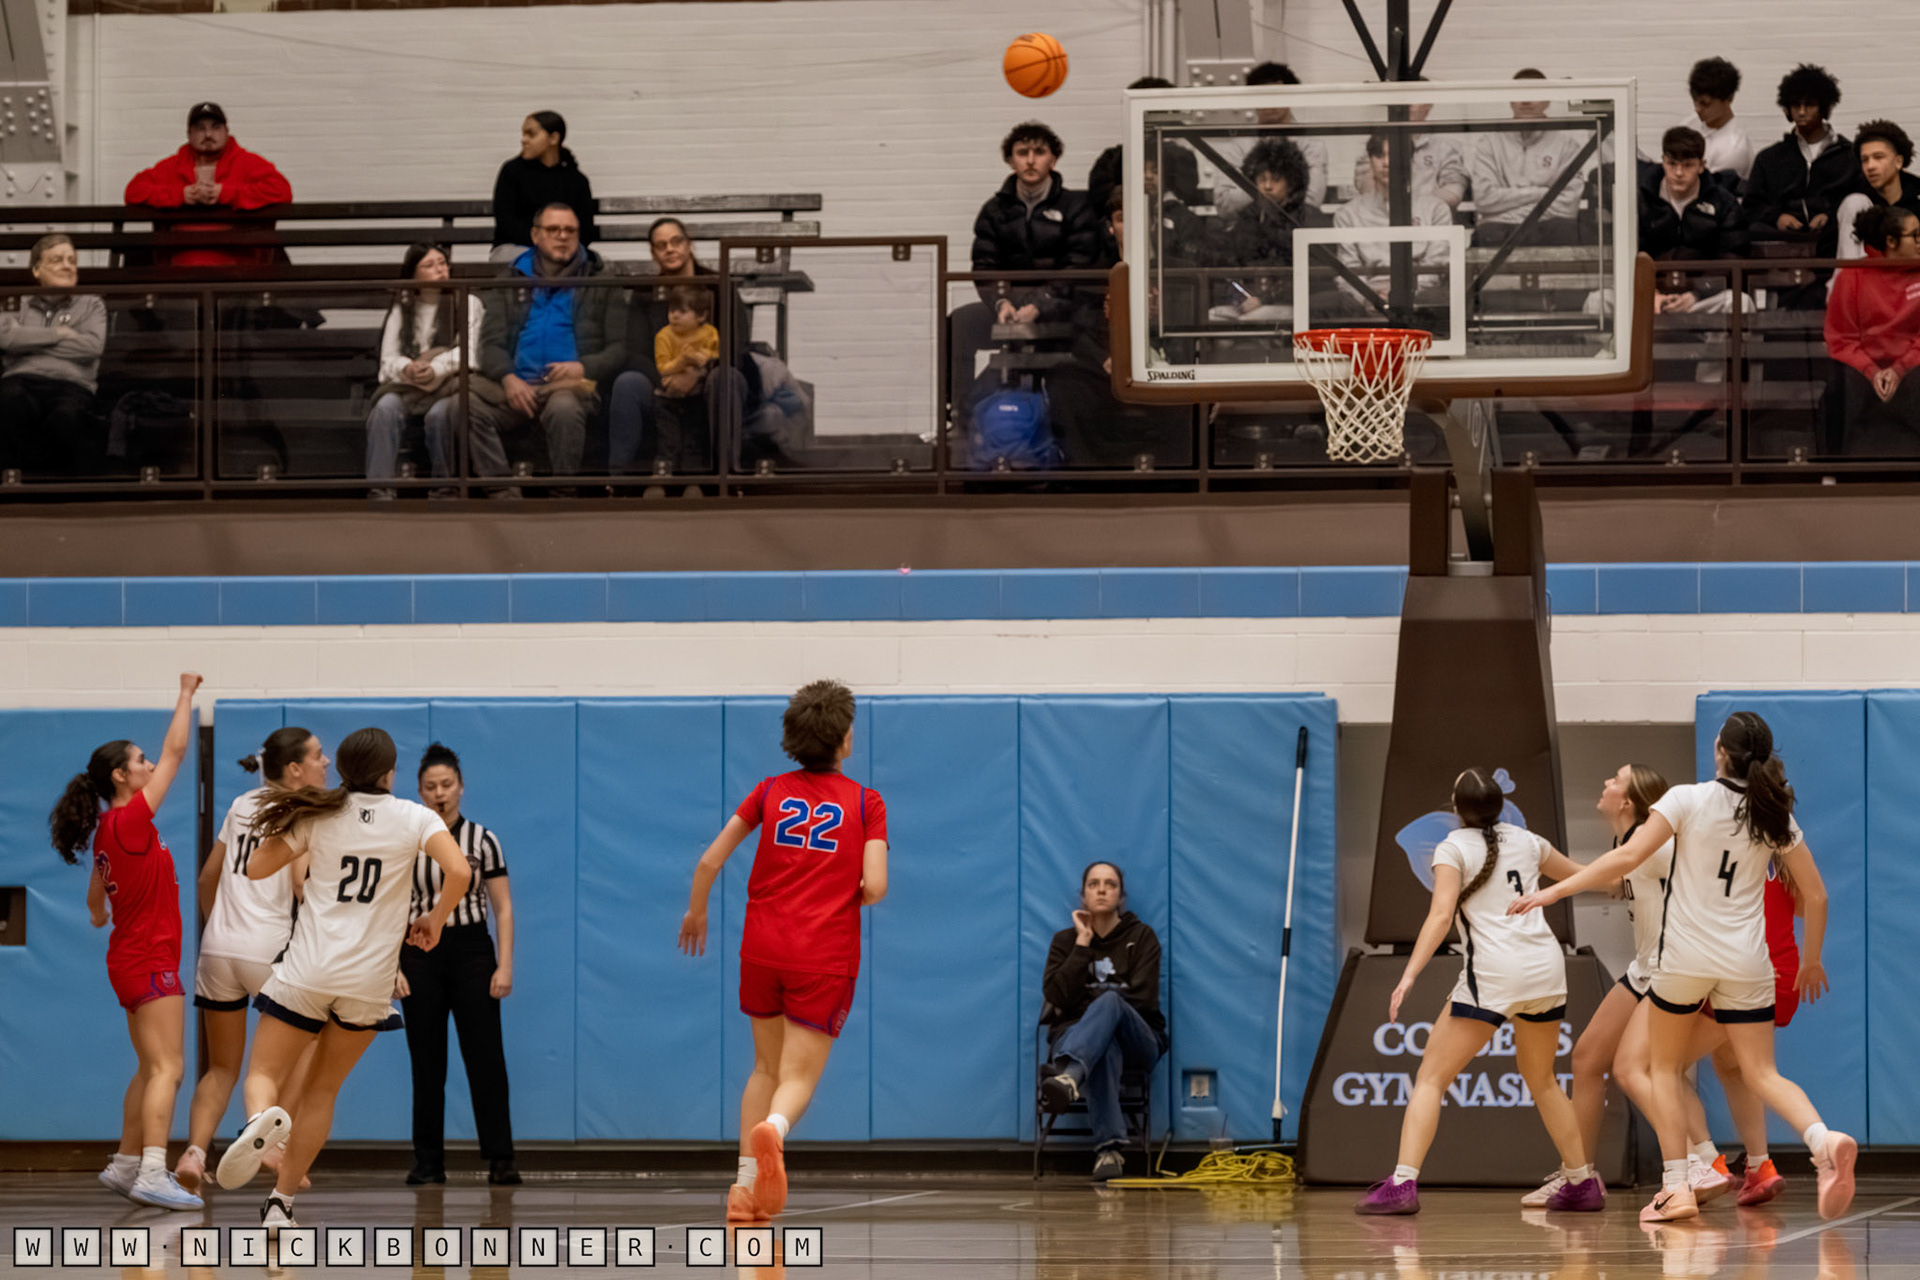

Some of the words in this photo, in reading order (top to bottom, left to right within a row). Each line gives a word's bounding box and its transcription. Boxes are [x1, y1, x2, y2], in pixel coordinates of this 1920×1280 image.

[1147, 369, 1195, 383] SPALDING
[774, 796, 845, 853] 22
[336, 855, 382, 904] 20
[1717, 850, 1739, 897] 4
[1373, 1021, 1573, 1056] COES
[1332, 1072, 1609, 1107] GYNASI
